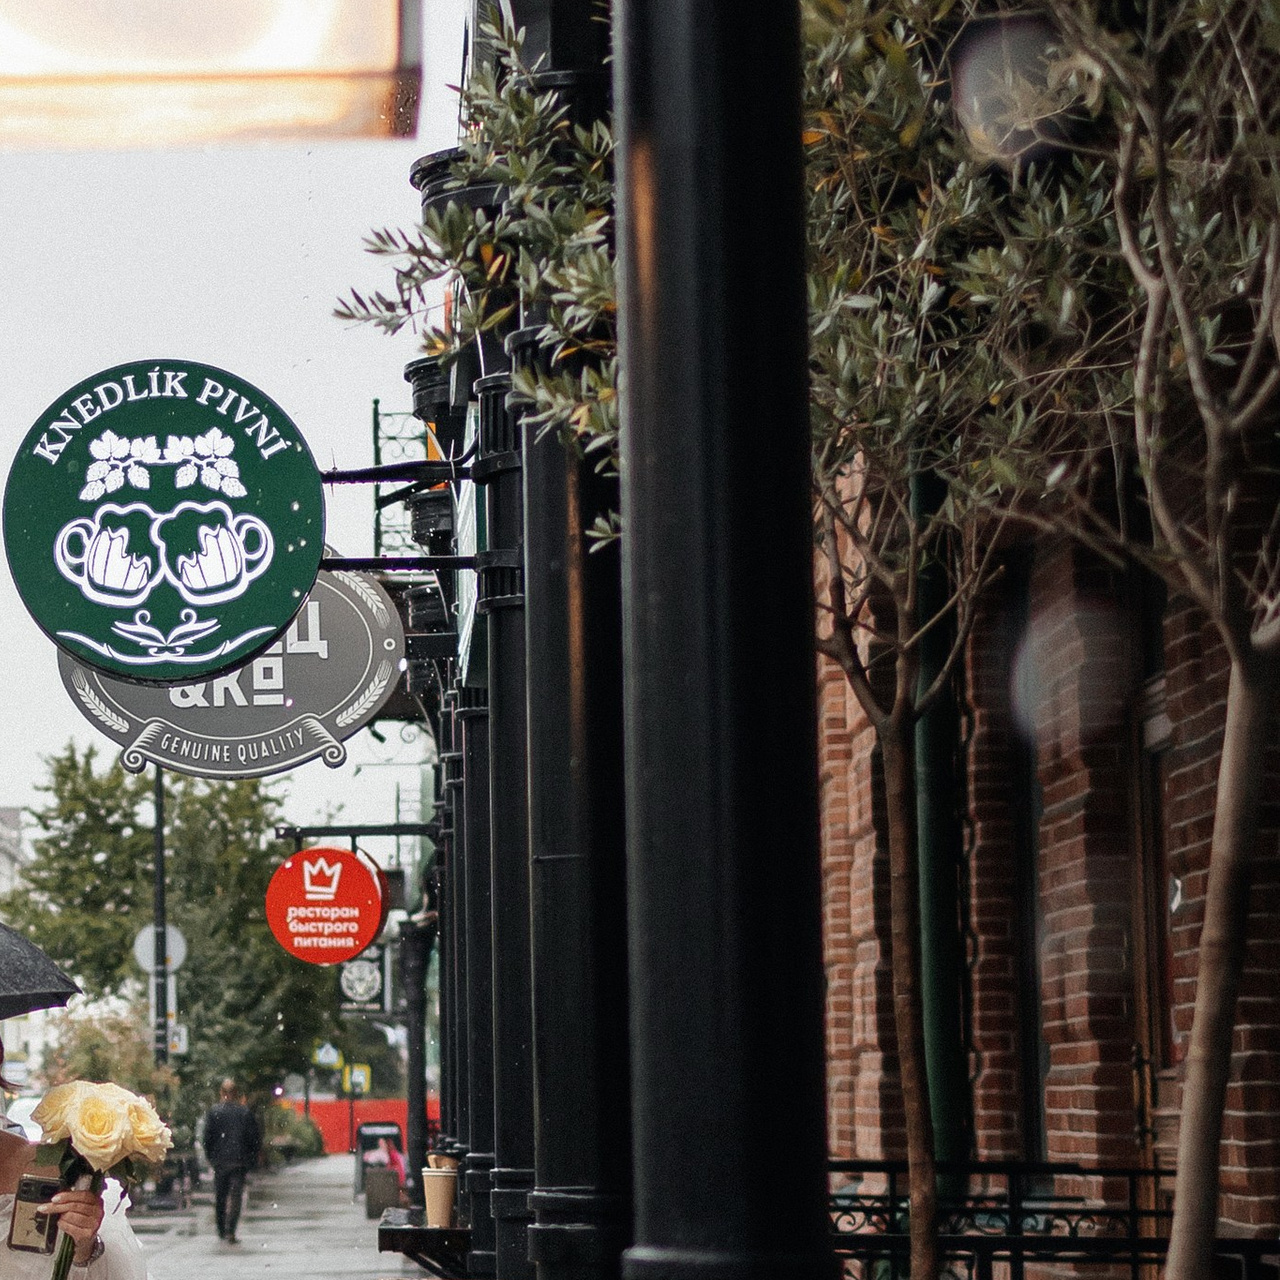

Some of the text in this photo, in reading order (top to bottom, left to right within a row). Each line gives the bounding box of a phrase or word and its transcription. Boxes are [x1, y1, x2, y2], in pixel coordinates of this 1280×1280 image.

[32, 365, 292, 466] KNEDLÍK PIVNÍ
[161, 728, 305, 766] GENUINE QUALITY
[287, 906, 360, 921] ресторан
[288, 919, 360, 935] быстрого
[293, 936, 355, 948] питания
